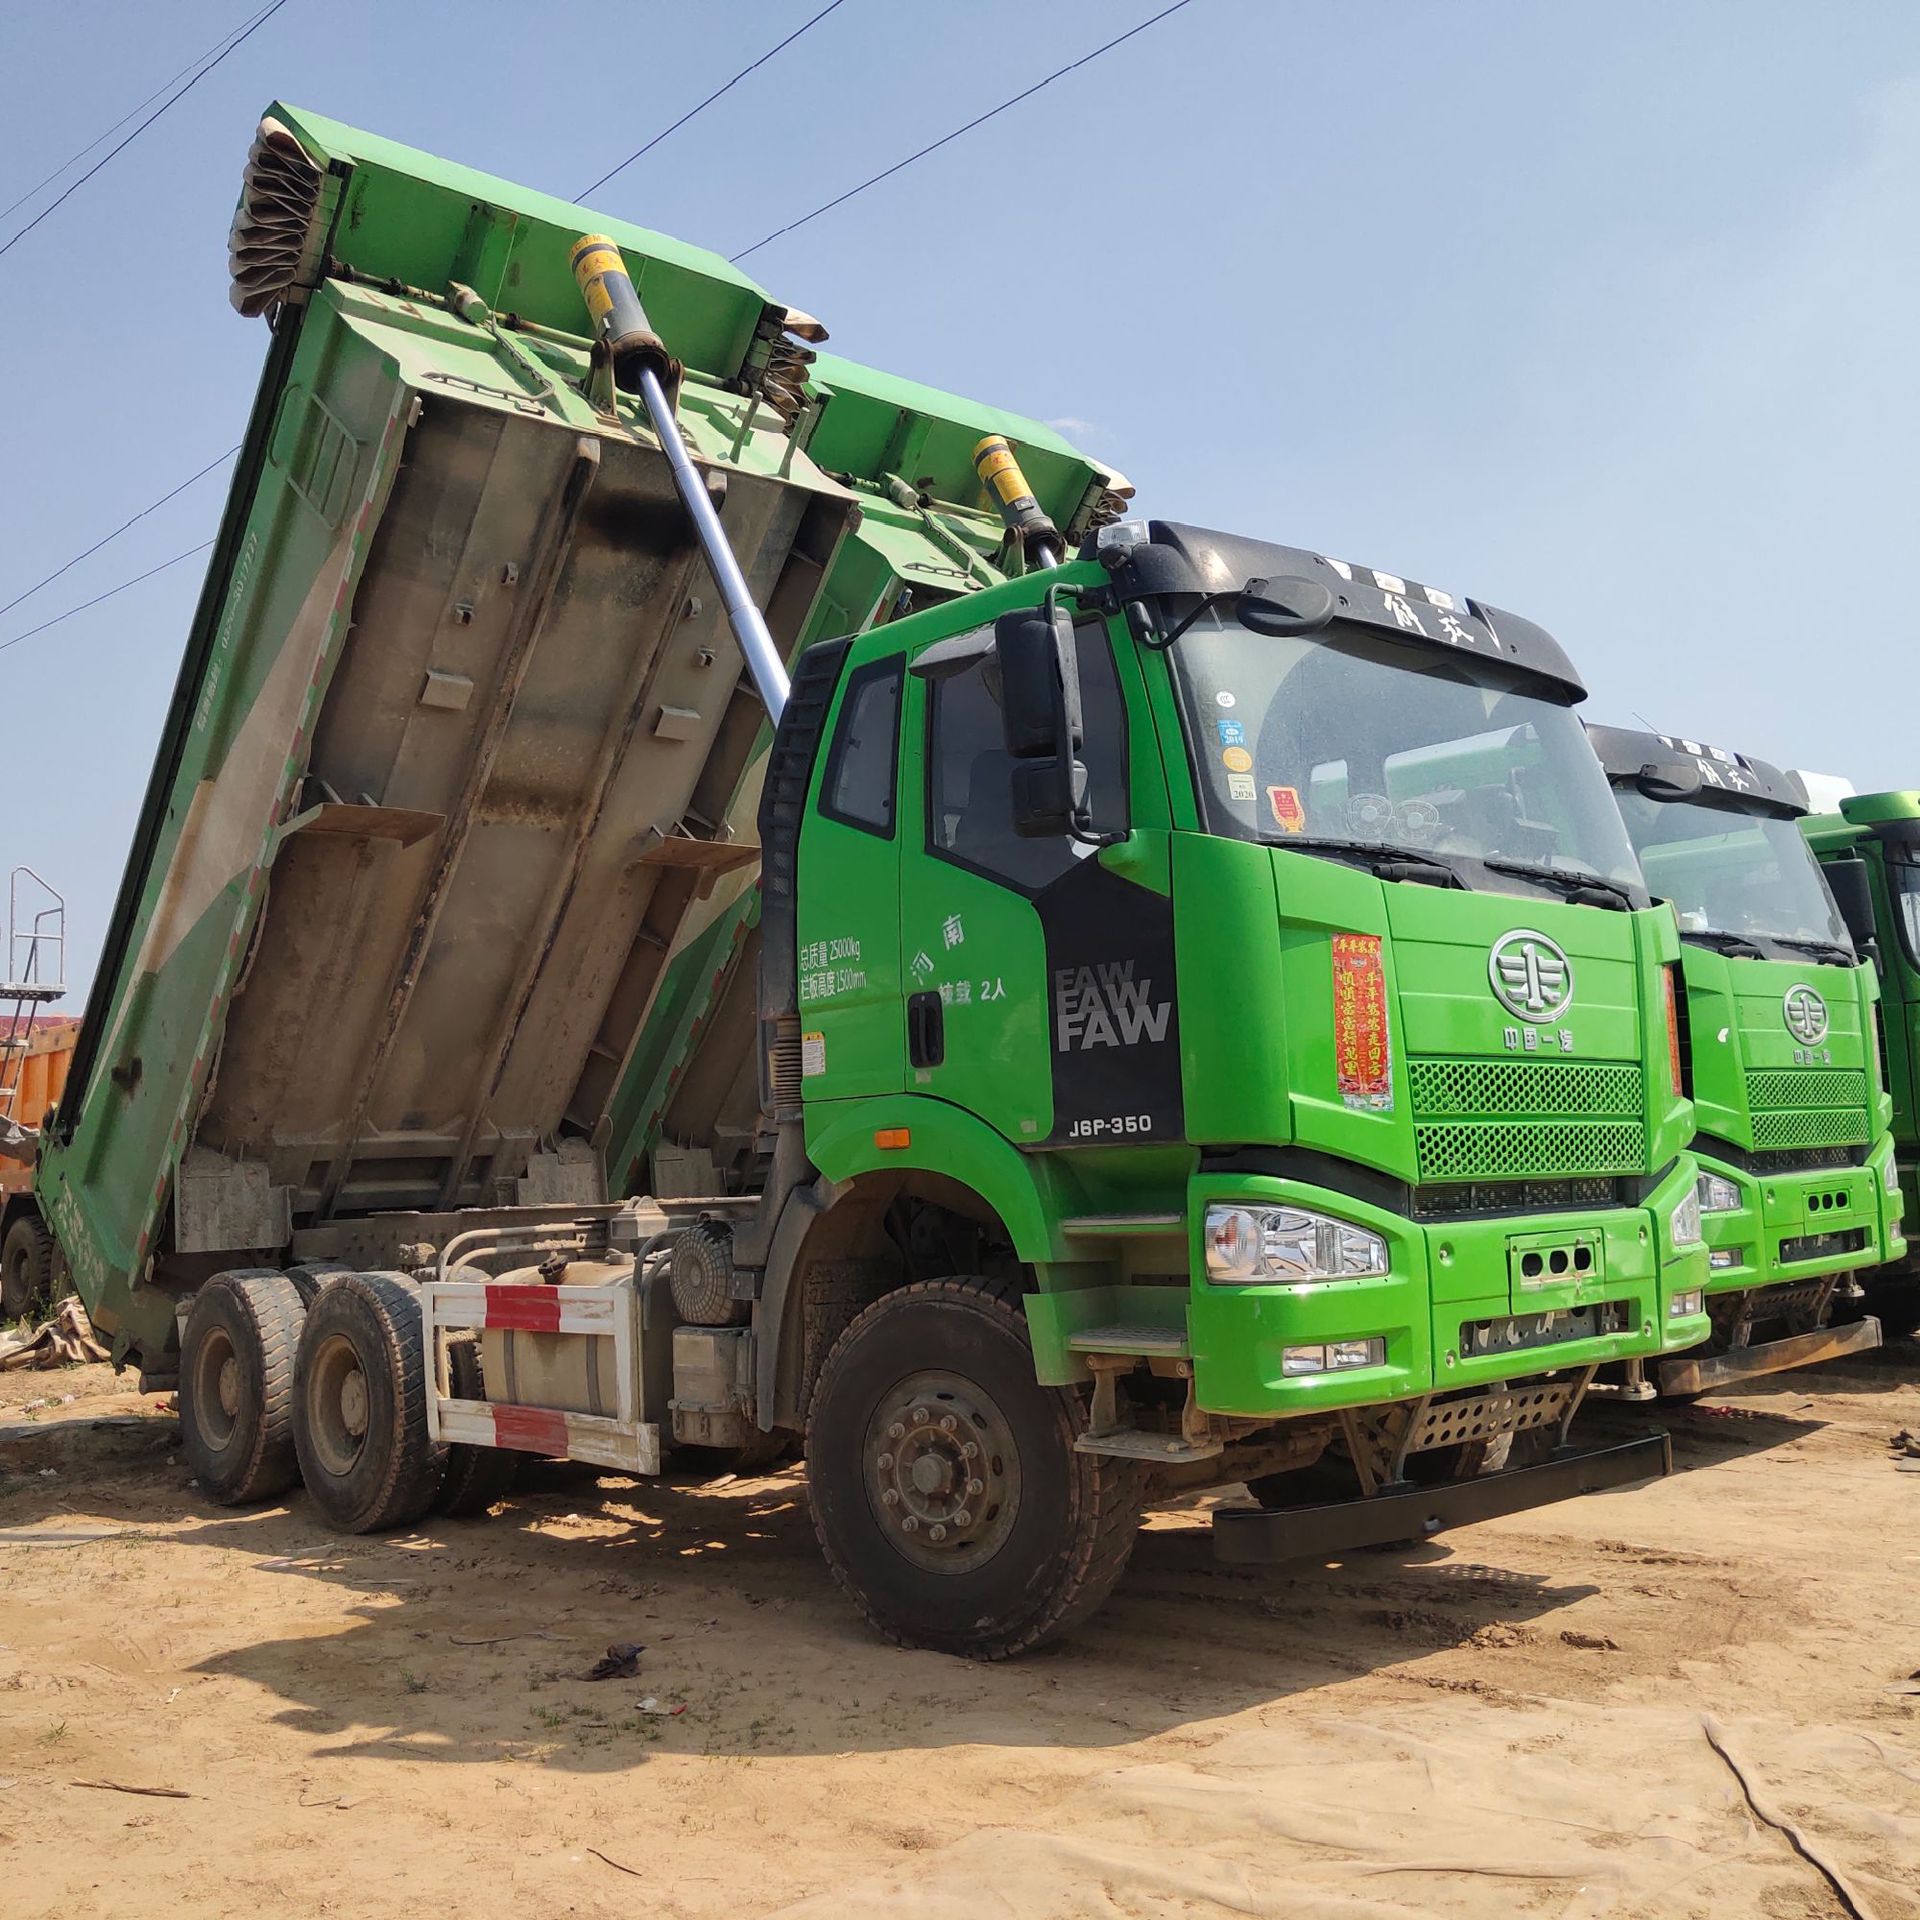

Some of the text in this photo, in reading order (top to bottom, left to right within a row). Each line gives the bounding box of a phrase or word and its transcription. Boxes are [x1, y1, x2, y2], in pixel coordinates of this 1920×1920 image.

[1233, 790, 1254, 799] 2020
[800, 936, 861, 972] 总质量 25000kg
[836, 967, 867, 993] 1500mm
[1058, 1002, 1171, 1052] FAW
[1504, 1026, 1575, 1052] 中国一汽
[1069, 1115, 1152, 1137] J6P-350
